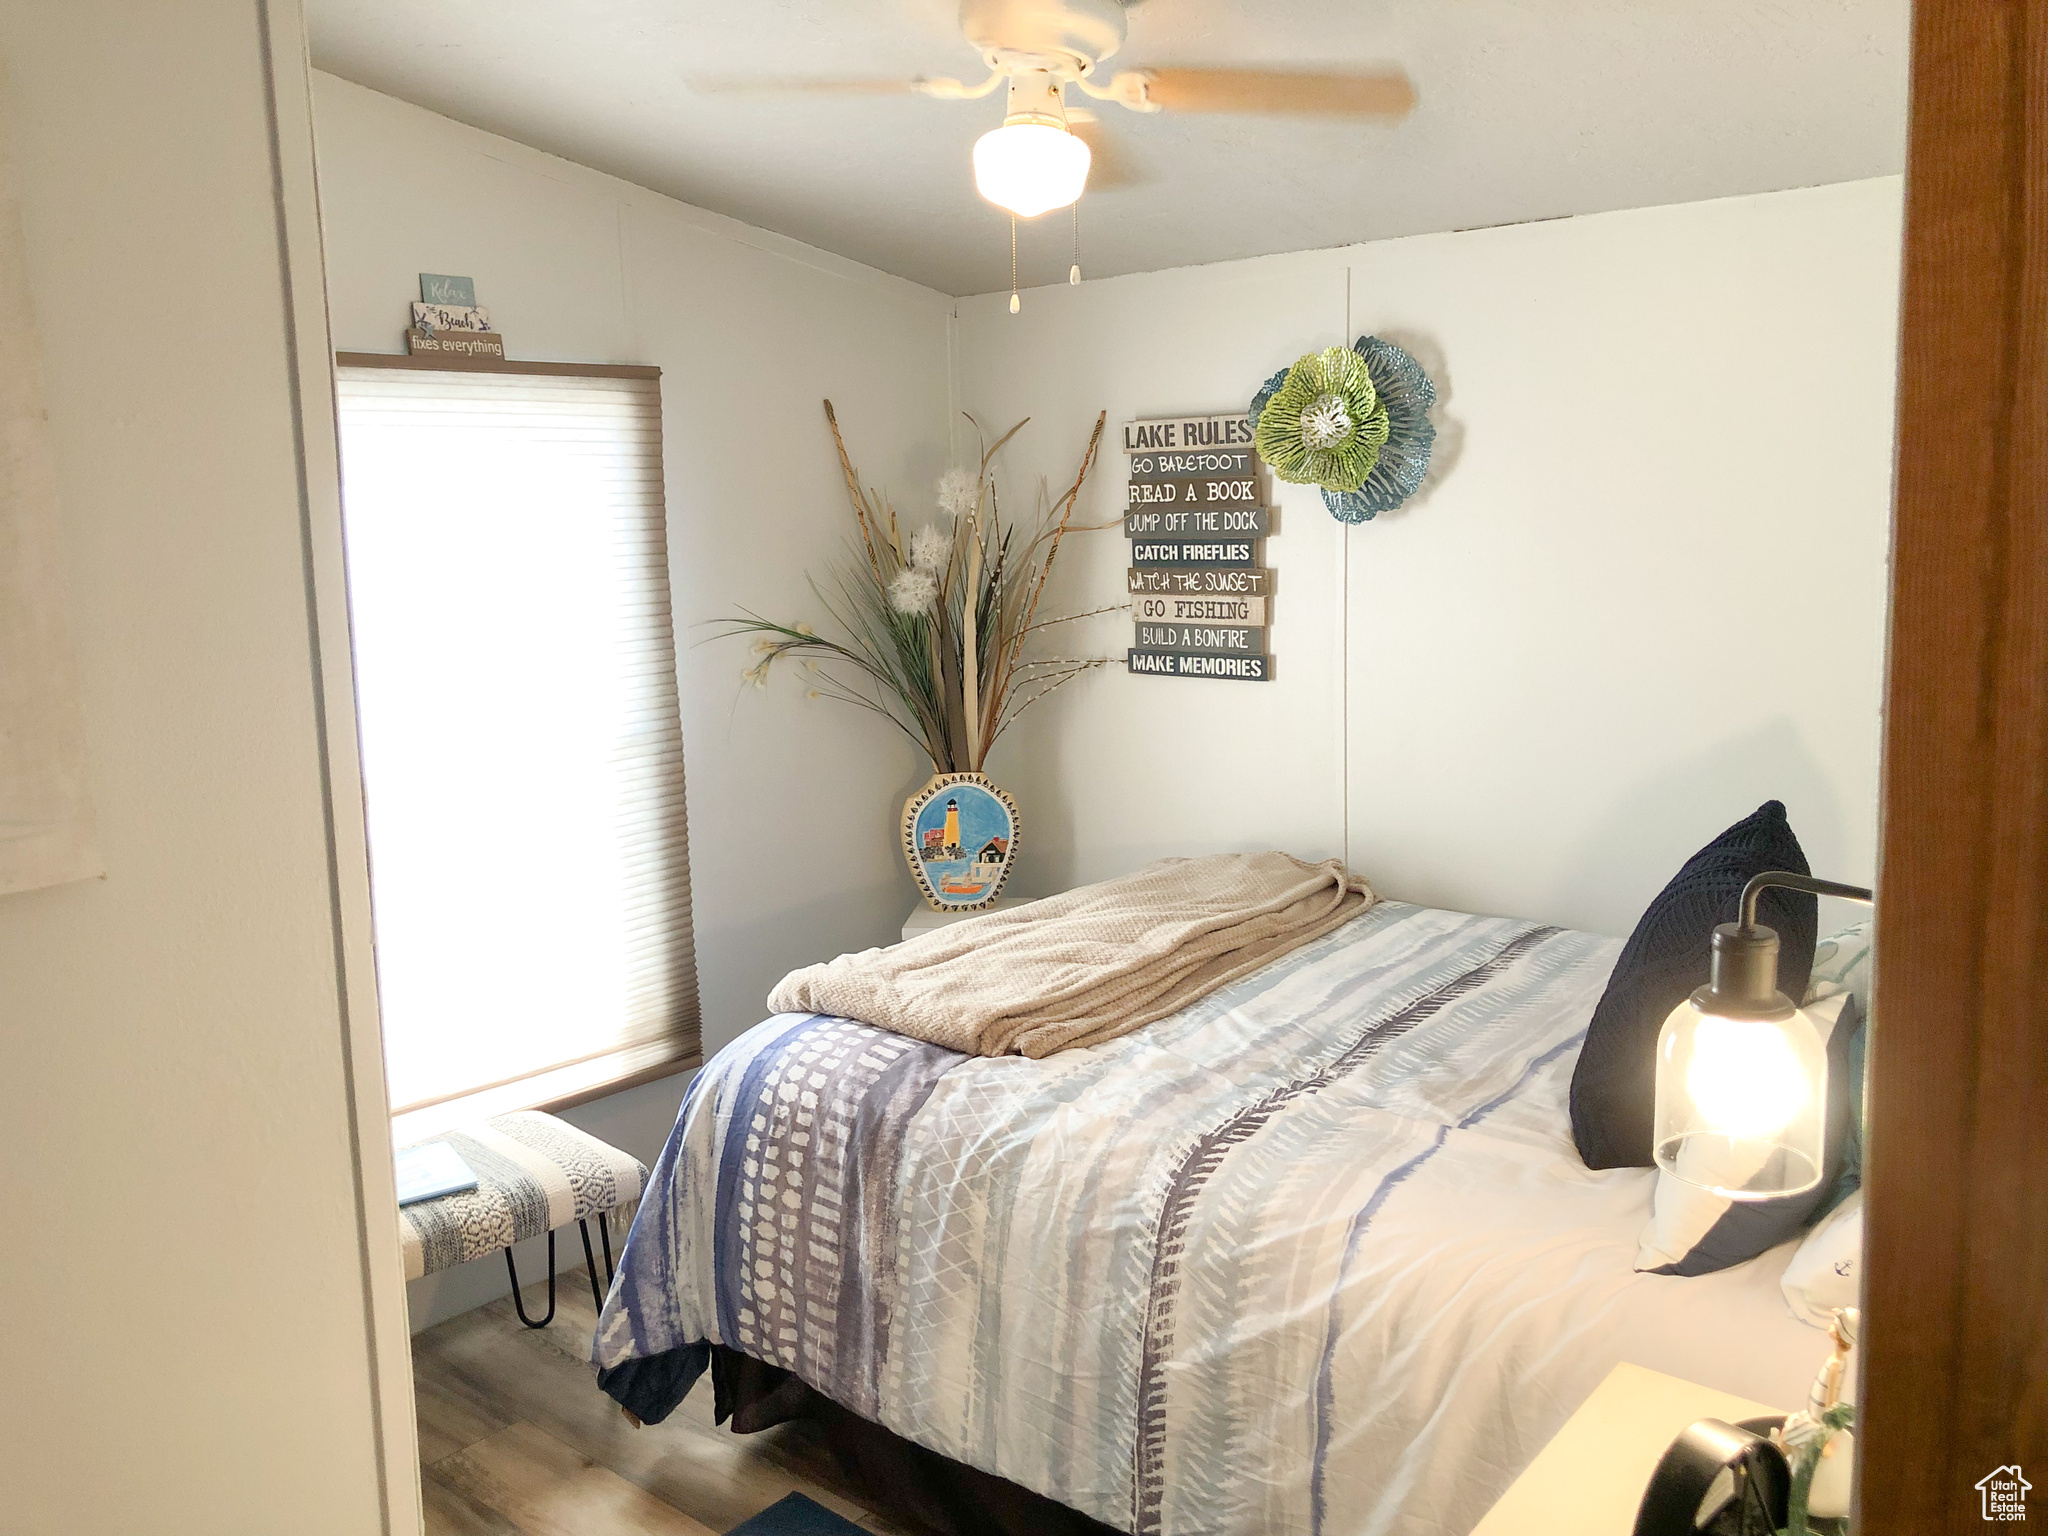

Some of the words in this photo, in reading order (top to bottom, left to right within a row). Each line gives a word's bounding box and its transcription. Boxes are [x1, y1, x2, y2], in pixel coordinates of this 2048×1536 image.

[435, 309, 474, 330] Beach
[412, 335, 439, 350] fixes
[442, 339, 502, 356] everything
[1125, 424, 1175, 449] LAKE
[1183, 419, 1253, 446] RULES
[1132, 457, 1153, 473] GO
[1158, 454, 1248, 472] BAREFOOT
[1129, 484, 1176, 503] READ
[1185, 483, 1198, 502] A
[1206, 481, 1255, 501] BOOK
[1129, 513, 1160, 532] JUMP
[1165, 512, 1189, 532] OFF
[1194, 512, 1219, 531] THE
[1224, 511, 1259, 530] DOCK
[1134, 544, 1178, 561] CATCH
[1182, 544, 1250, 560] FIREFLIES
[1129, 572, 1170, 591] WATCH
[1173, 572, 1202, 591] THE
[1205, 572, 1262, 592] SUNSET
[1144, 600, 1165, 617] GO
[1174, 601, 1250, 620] FISHING
[1142, 627, 1177, 646] BUILD
[1182, 628, 1191, 647] A
[1194, 628, 1249, 648] BONFIRE
[1132, 654, 1174, 672] MAKE
[1179, 656, 1262, 677] MEMORIES
